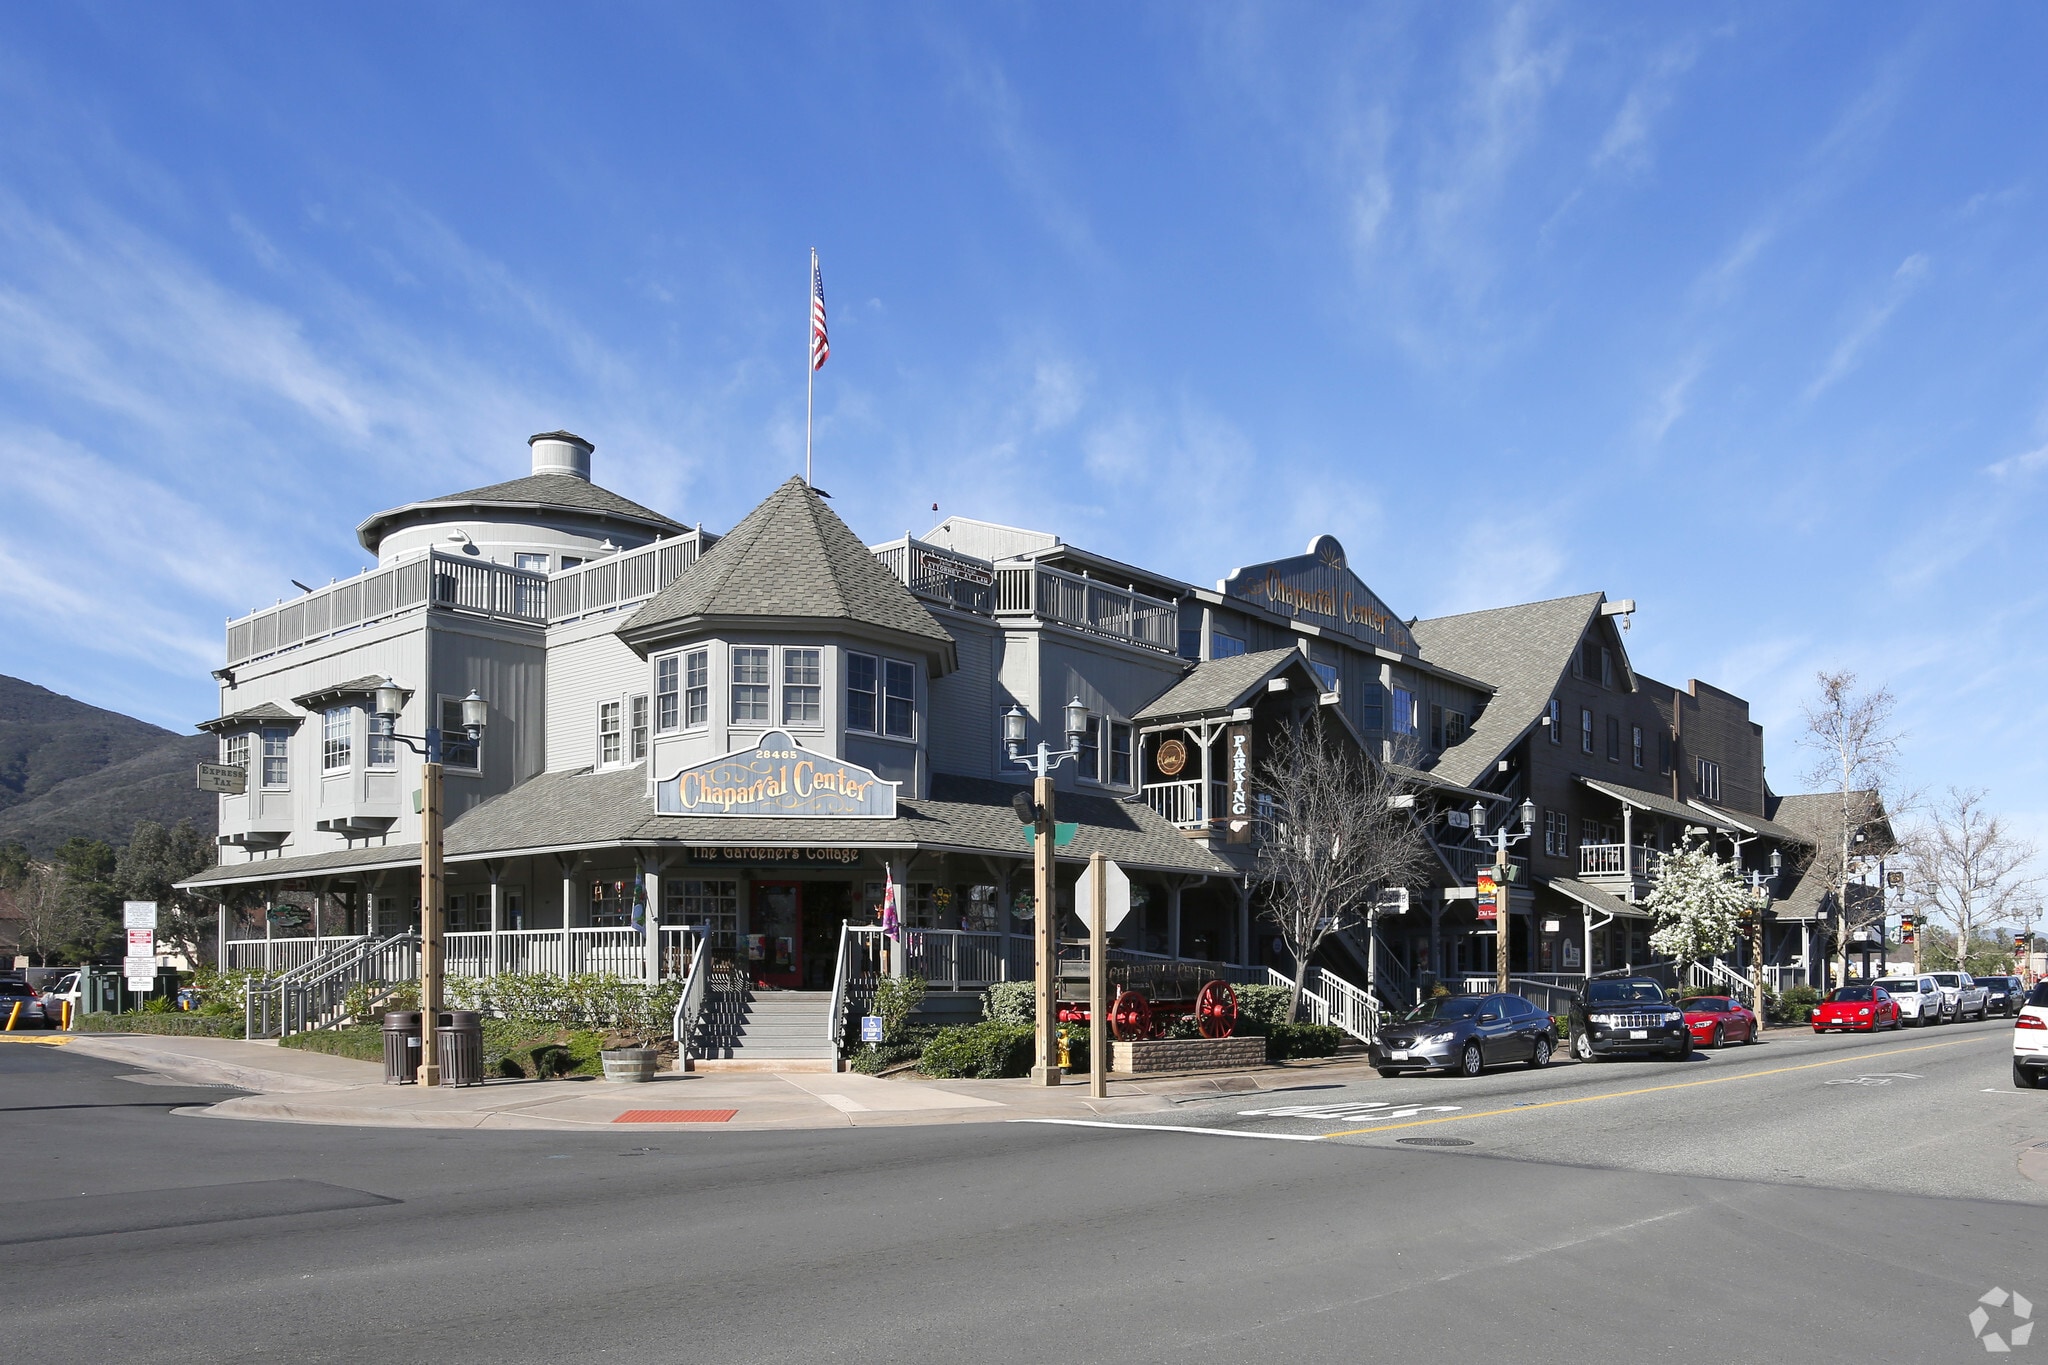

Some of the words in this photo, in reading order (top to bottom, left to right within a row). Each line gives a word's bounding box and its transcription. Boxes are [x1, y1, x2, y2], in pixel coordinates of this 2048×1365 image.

[1265, 566, 1338, 617] Chaparral
[1343, 591, 1391, 635] Center
[755, 750, 797, 760] 28465
[1231, 735, 1247, 815] PARKING
[679, 765, 788, 813] Chaparral
[793, 760, 874, 803] Center
[691, 846, 718, 860] The
